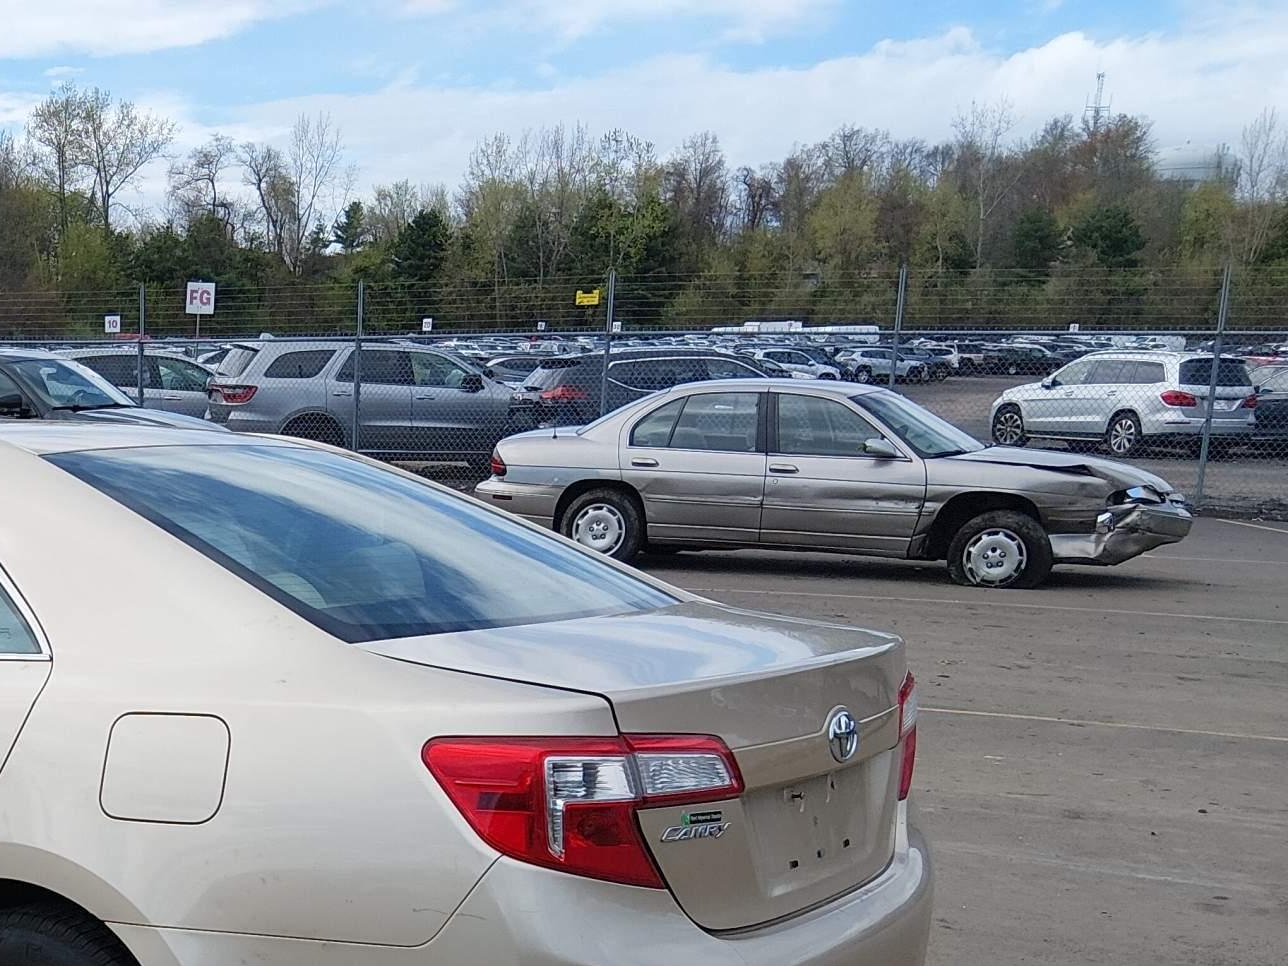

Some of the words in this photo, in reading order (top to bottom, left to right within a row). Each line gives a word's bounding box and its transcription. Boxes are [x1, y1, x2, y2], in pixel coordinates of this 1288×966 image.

[189, 289, 211, 306] FG
[108, 320, 118, 329] 10
[660, 822, 732, 842] CAMRY
